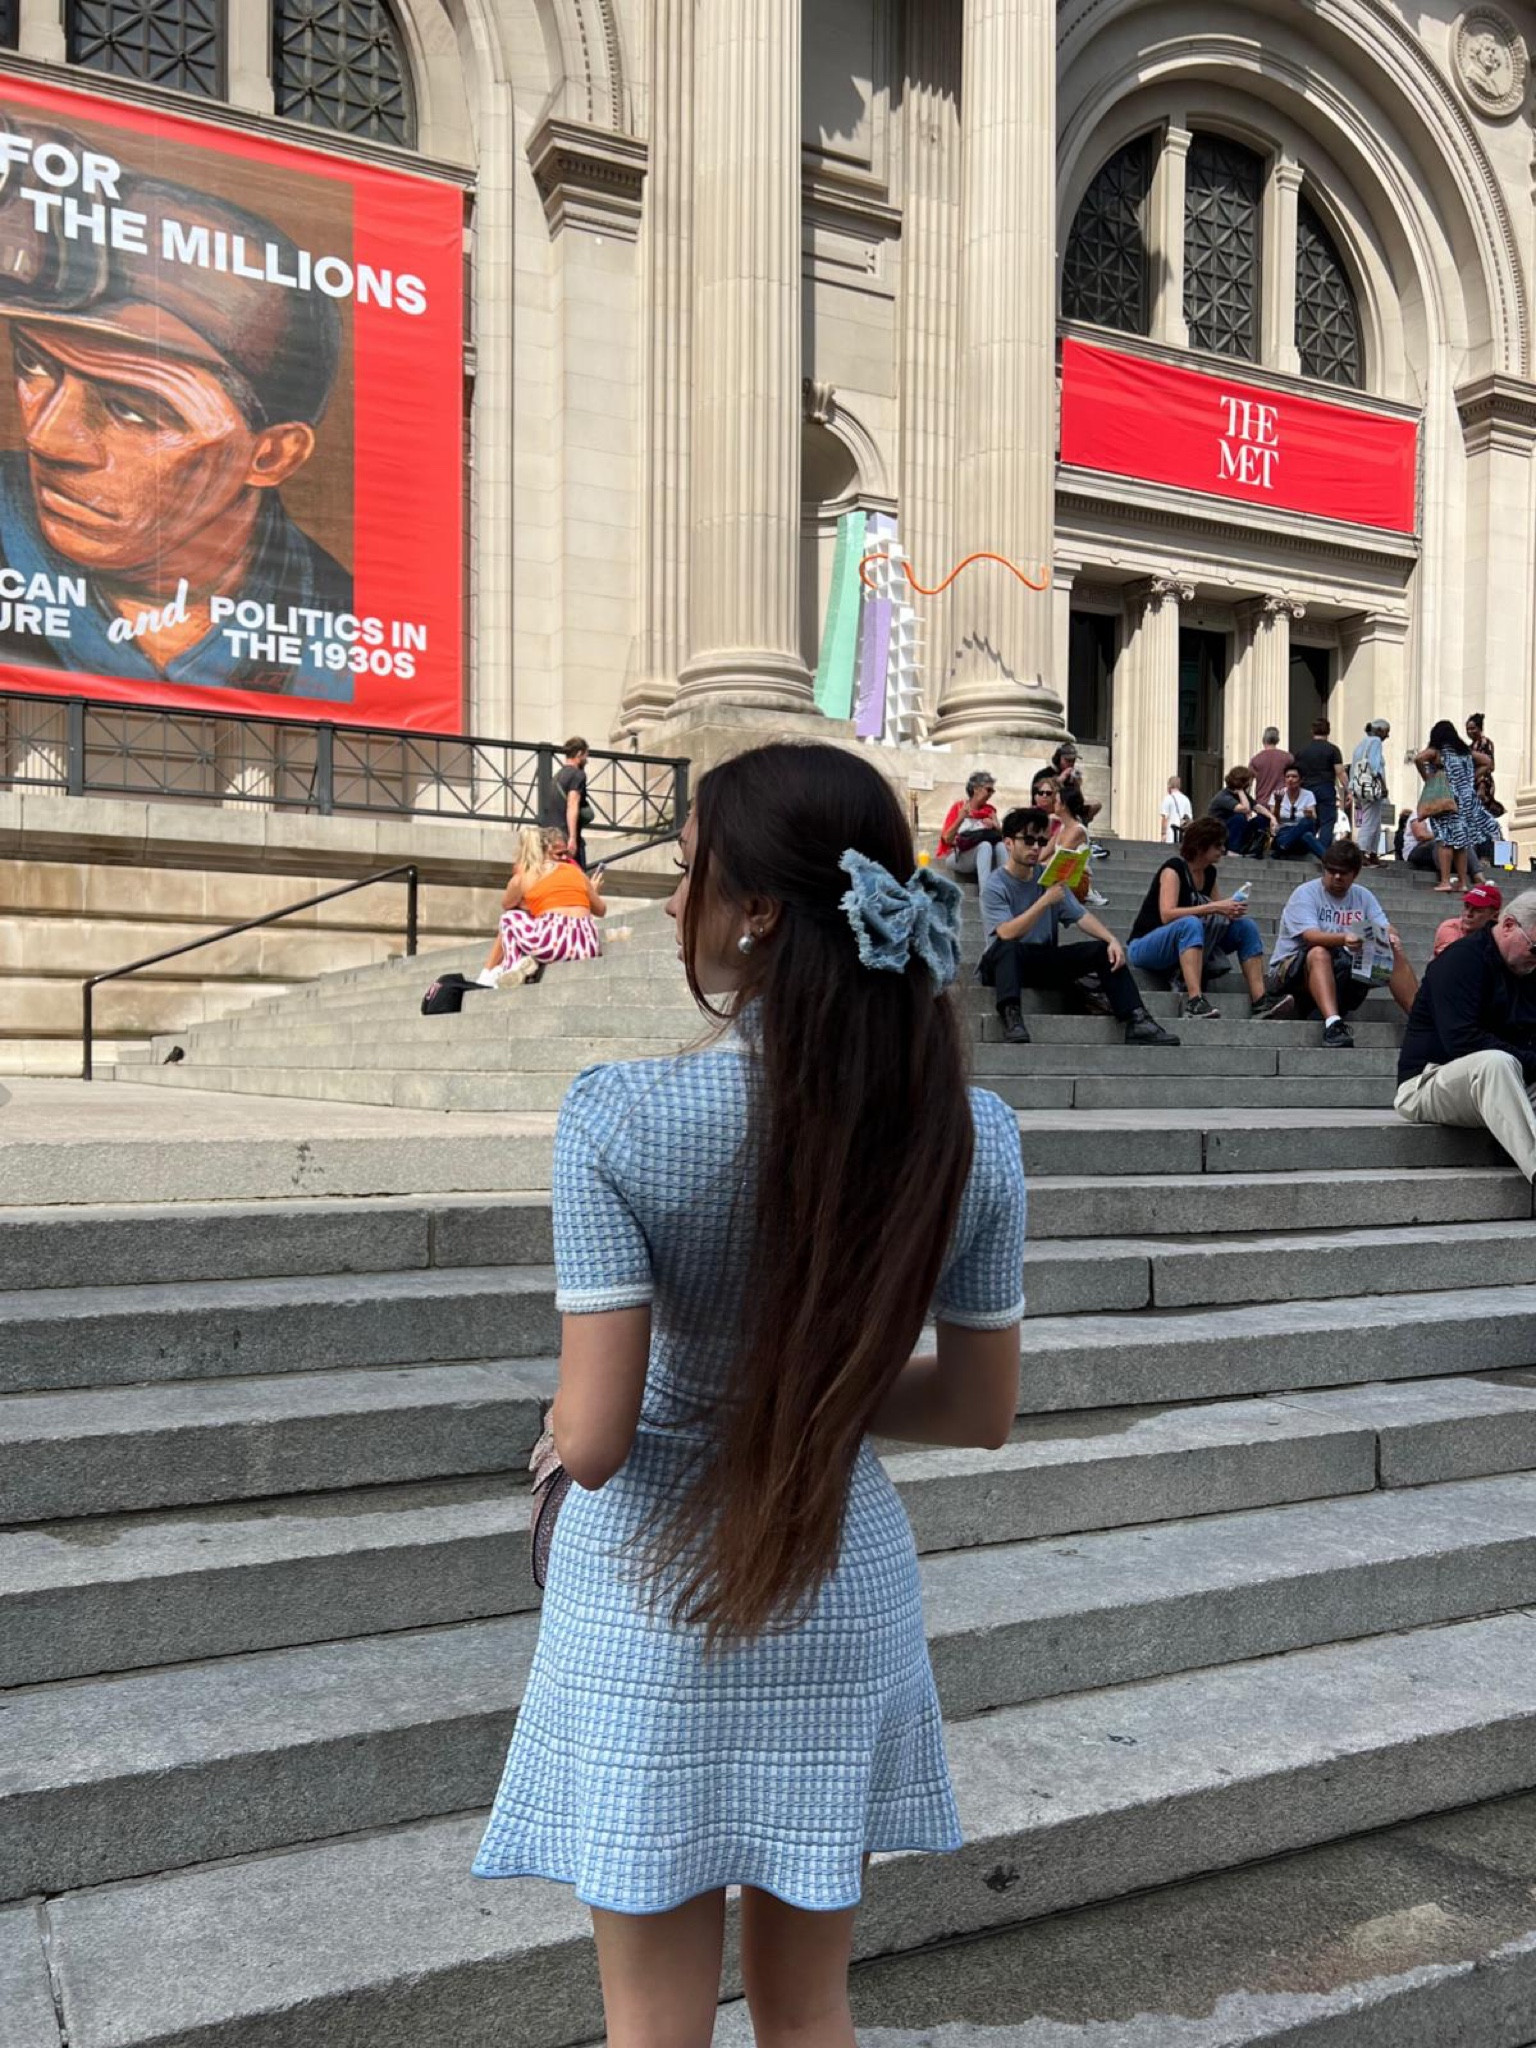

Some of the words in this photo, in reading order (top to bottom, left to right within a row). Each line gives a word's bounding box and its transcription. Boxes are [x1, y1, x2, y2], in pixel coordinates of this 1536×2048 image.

[0, 132, 121, 199] FOR
[20, 187, 148, 255] THE
[161, 219, 427, 316] MILLIONS
[1220, 394, 1279, 447] THE
[1217, 438, 1280, 490] MET
[0, 568, 87, 608] CAN
[106, 578, 191, 645] and
[210, 595, 385, 645] POLITICS
[391, 621, 427, 651] IN
[222, 629, 303, 665] THE
[309, 641, 416, 679] 1930S
